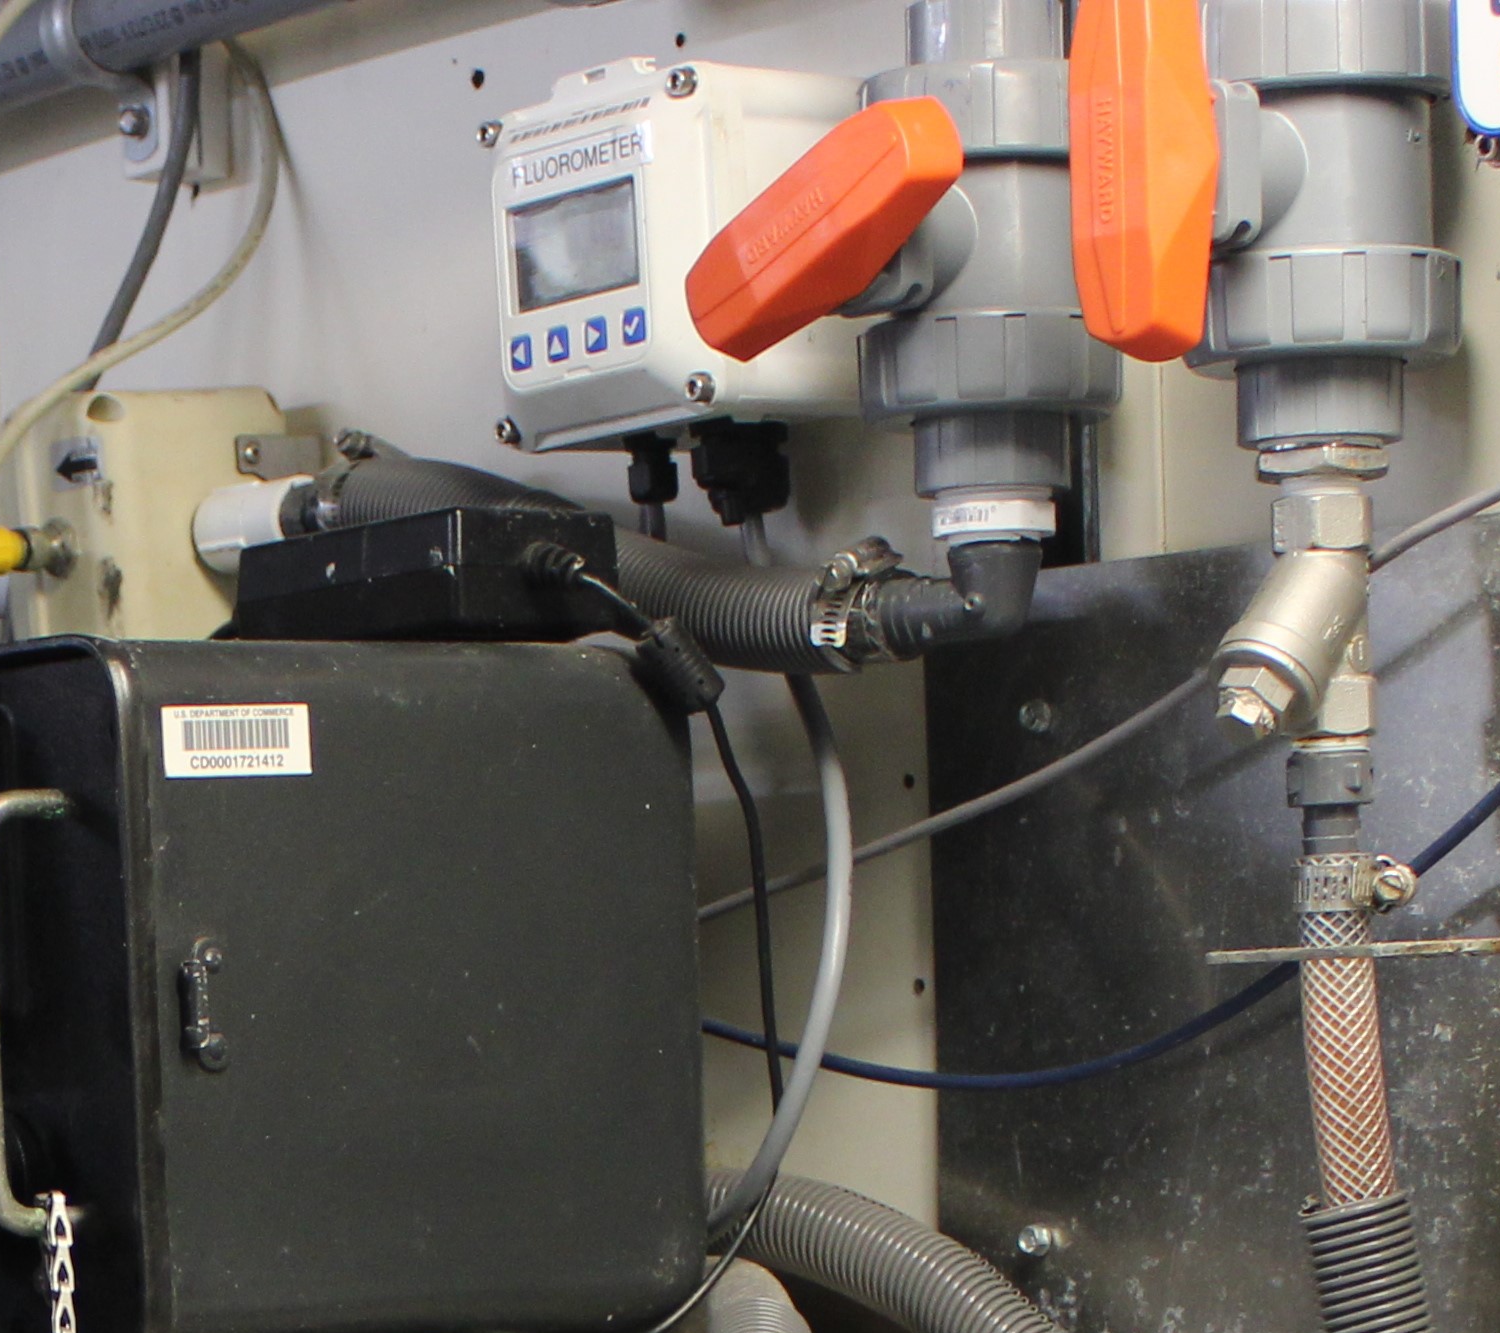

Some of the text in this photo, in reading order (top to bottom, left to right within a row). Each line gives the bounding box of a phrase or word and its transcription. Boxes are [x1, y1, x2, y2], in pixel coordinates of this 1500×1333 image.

[511, 132, 643, 188] FLUOROMETER
[1096, 98, 1115, 225] HAYWARD
[746, 186, 825, 264] HAYWARD
[189, 708, 240, 718] DEPARTMENT
[240, 708, 250, 717] OF
[252, 707, 295, 717] COMMERCE
[190, 753, 285, 770] CD0001721412
